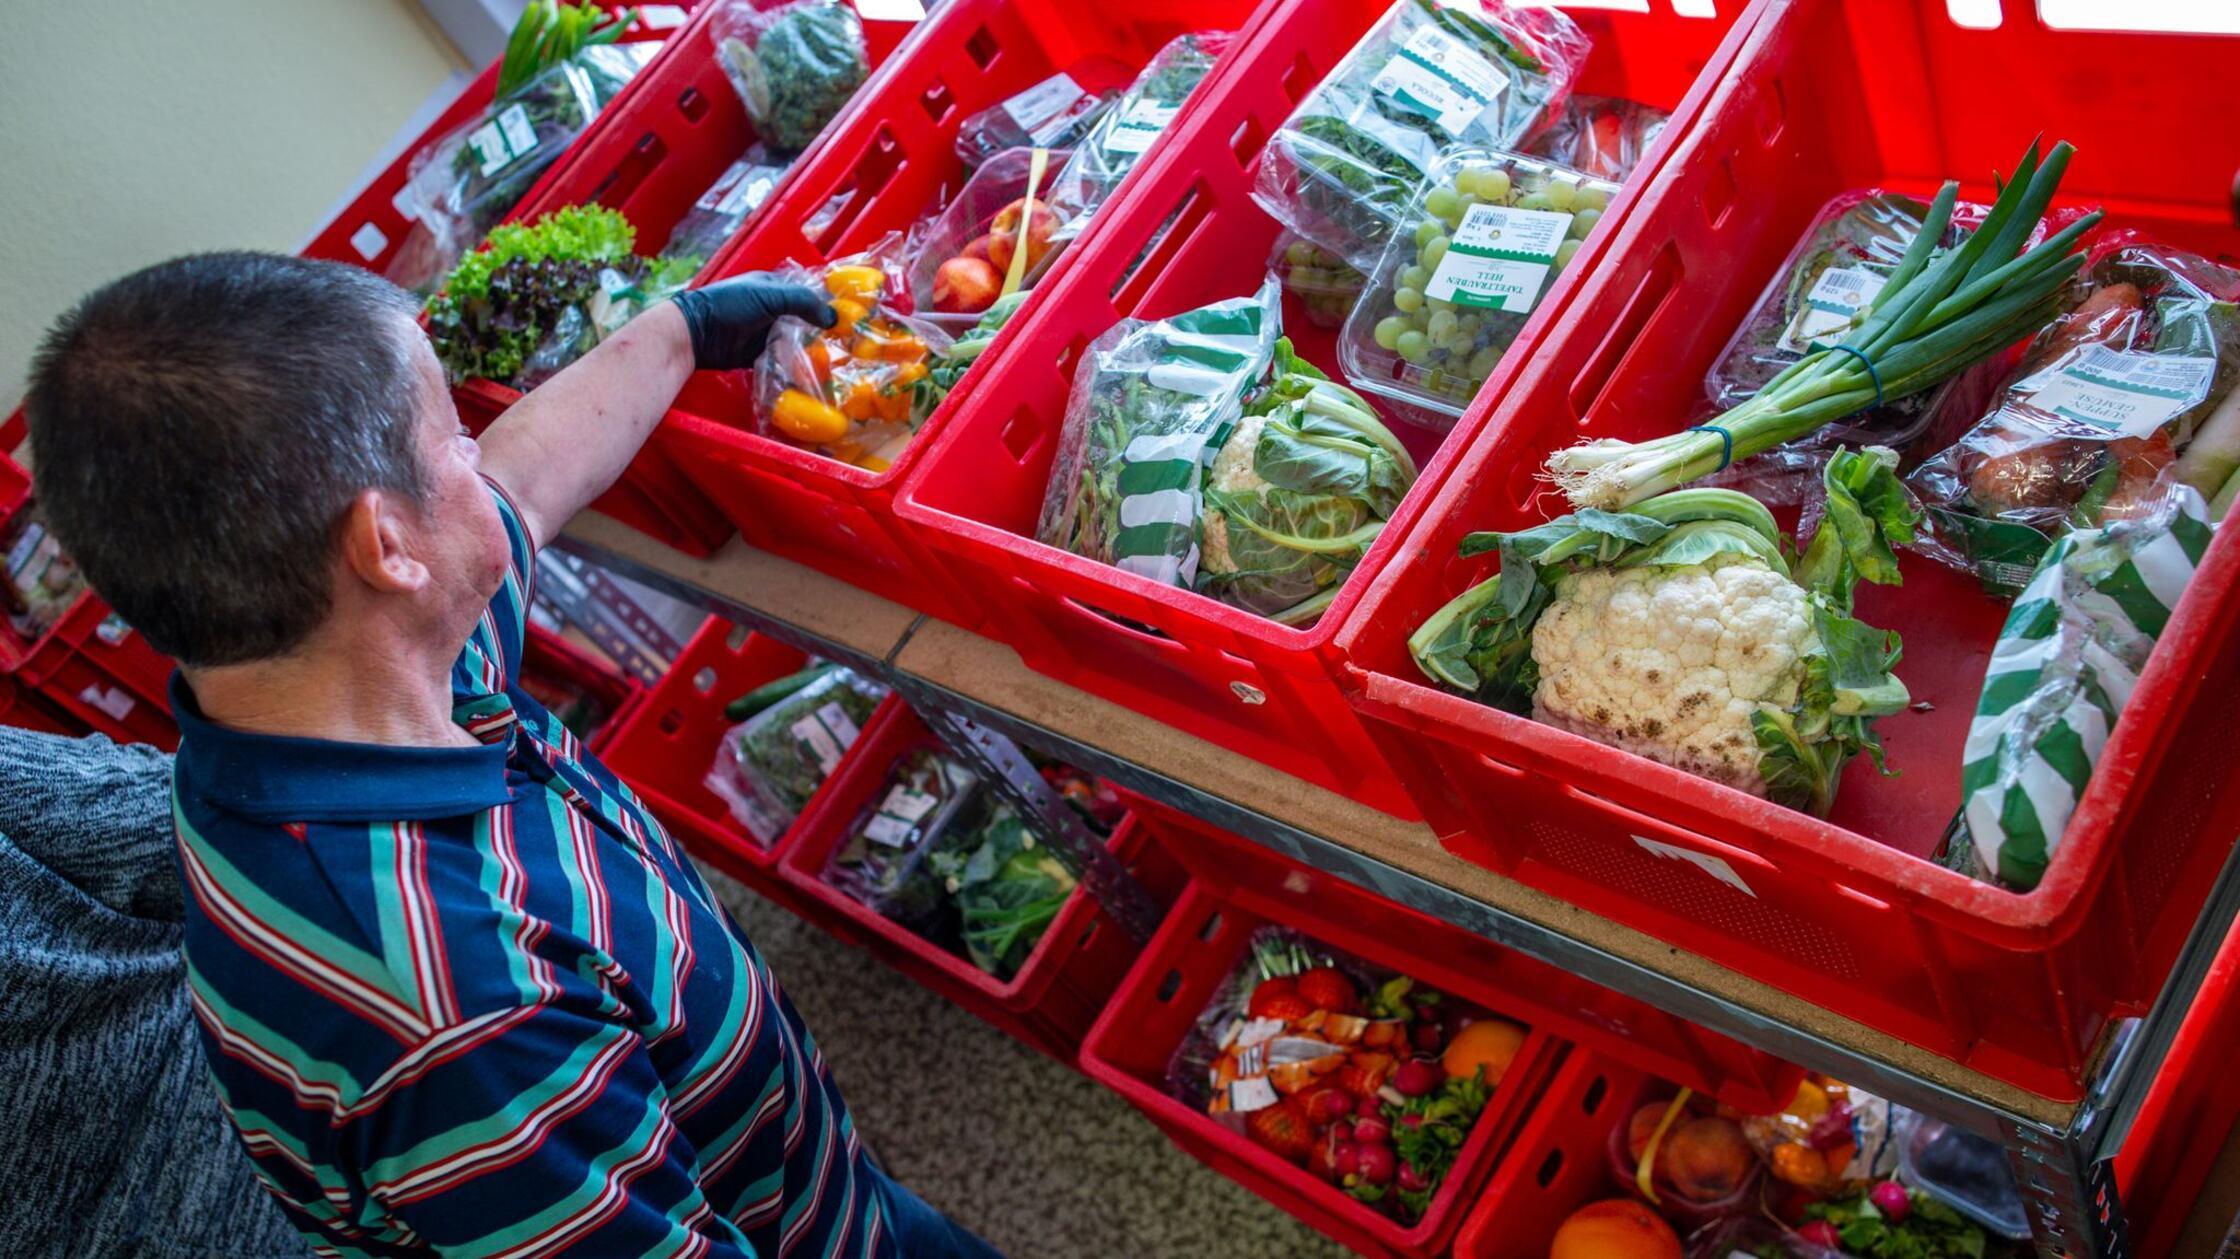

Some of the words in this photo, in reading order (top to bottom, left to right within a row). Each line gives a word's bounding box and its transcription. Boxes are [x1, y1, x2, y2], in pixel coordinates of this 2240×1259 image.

[1411, 81, 1444, 103] RUCOLA
[1446, 276, 1523, 293] TAFELTRAUBEN
[1477, 271, 1504, 281] HELL
